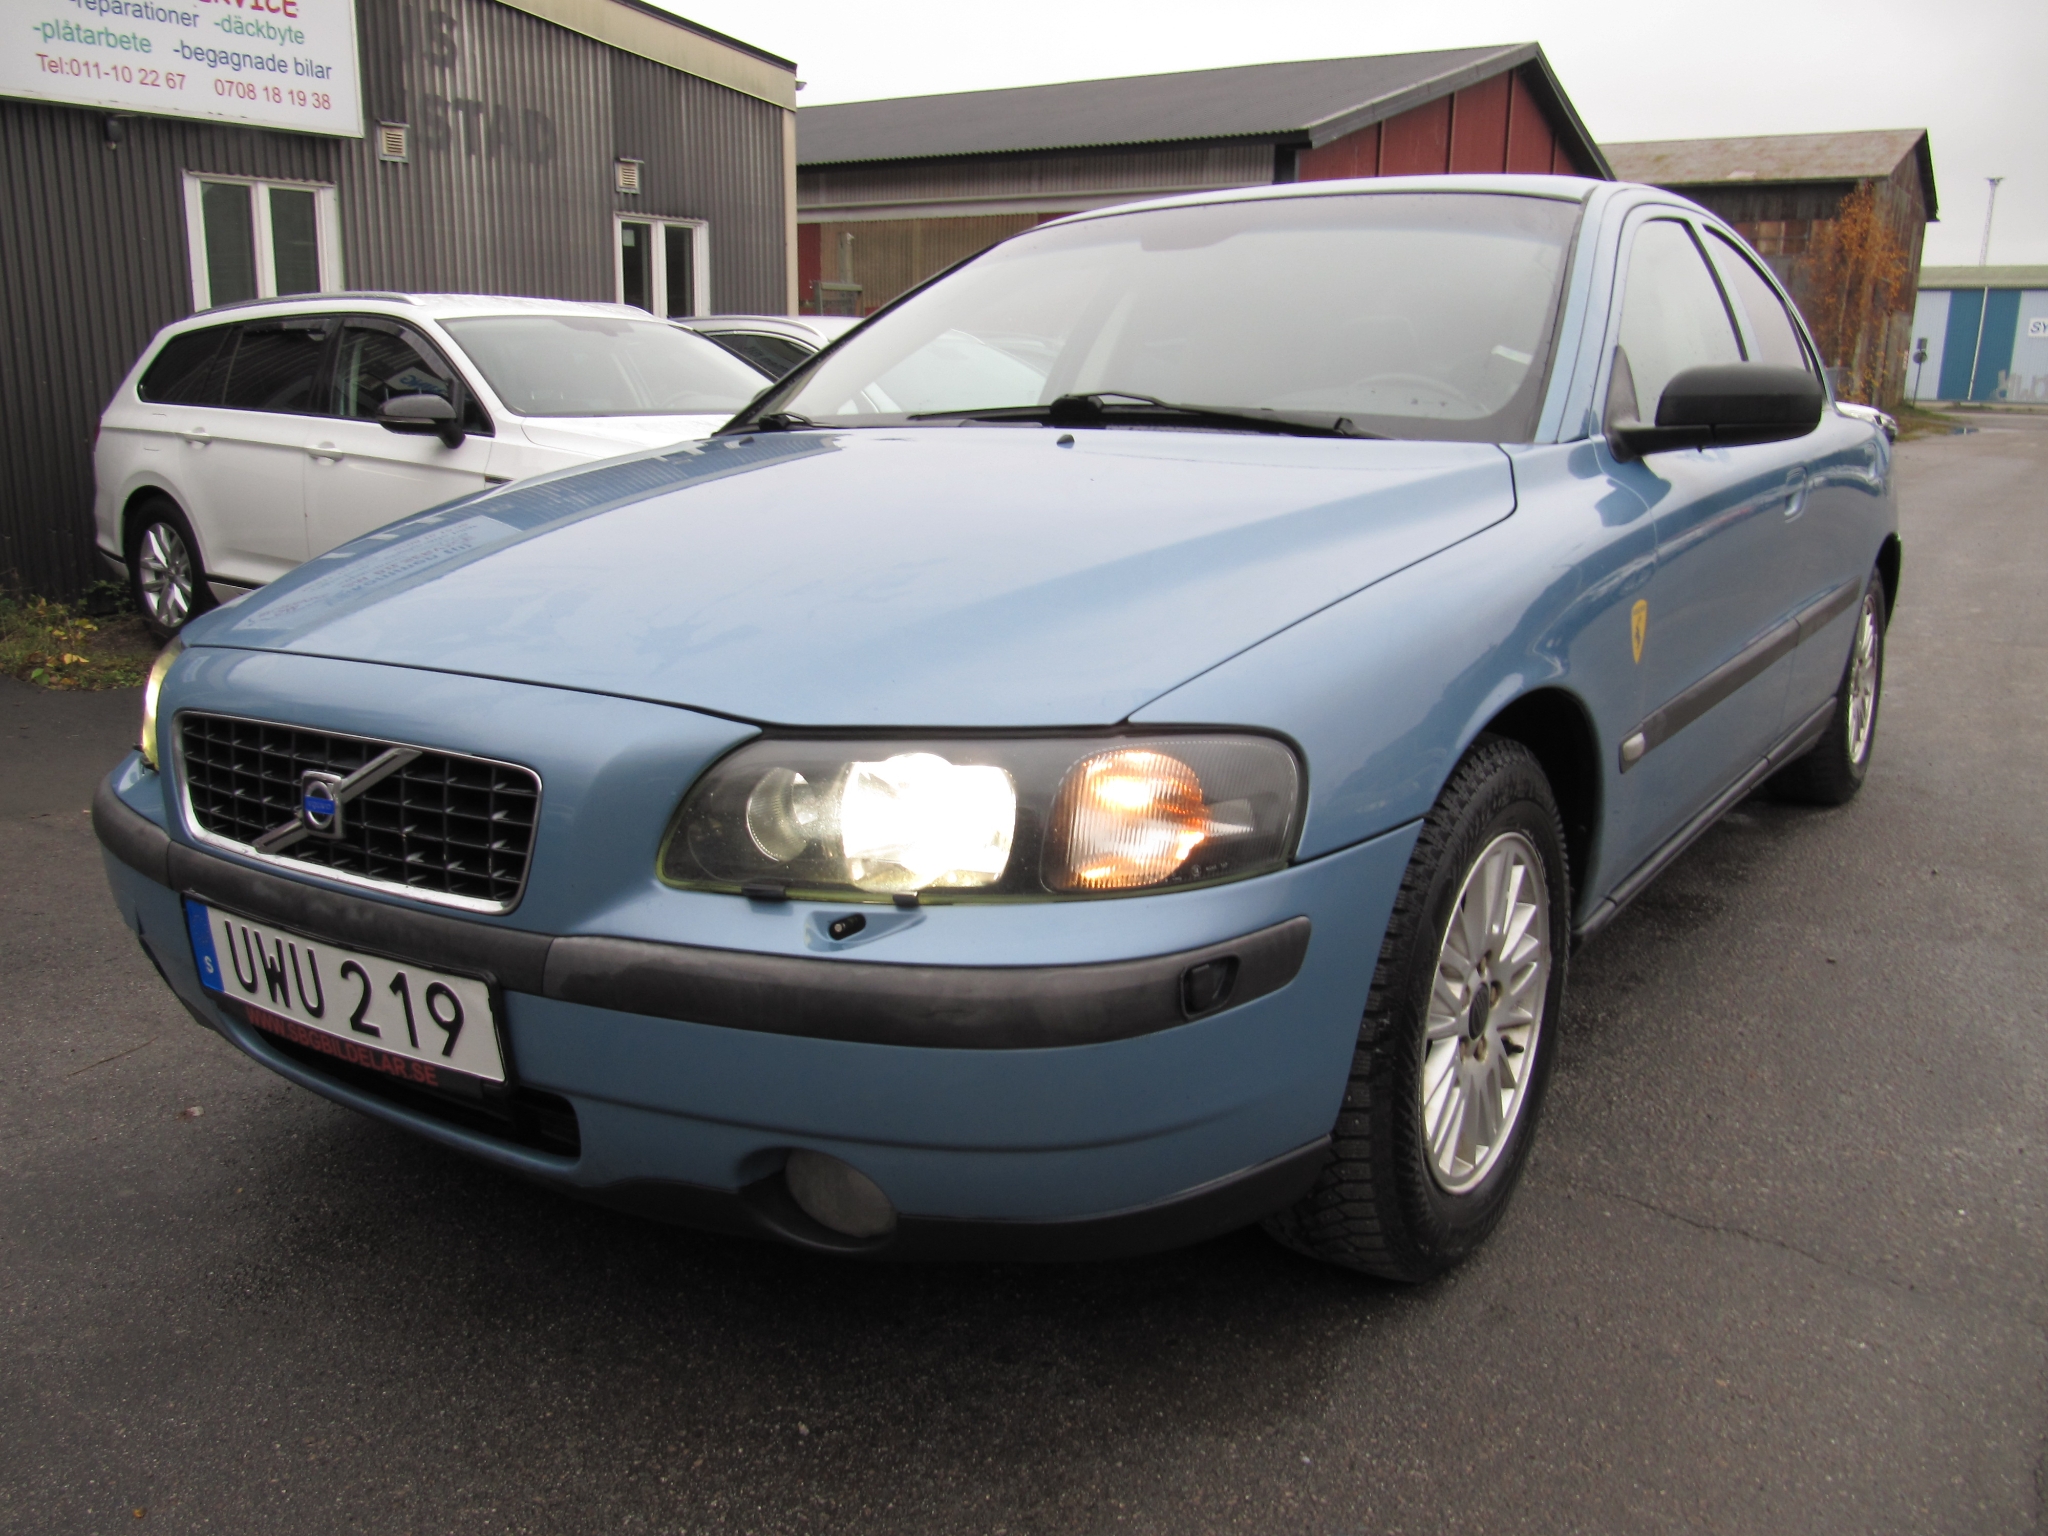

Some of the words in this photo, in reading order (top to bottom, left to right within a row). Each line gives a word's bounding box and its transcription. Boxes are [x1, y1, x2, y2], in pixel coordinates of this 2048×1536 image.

[33, 19, 152, 53] -plåtarbete
[173, 40, 288, 74] -begagnade
[294, 55, 331, 79] bilar
[214, 15, 305, 46] -däckbyte
[36, 53, 133, 83] Tel:011-10
[139, 67, 161, 87] 22
[166, 72, 186, 90] 67
[214, 79, 256, 100] 0708
[263, 84, 281, 104] 18
[288, 88, 306, 107] 19
[312, 92, 331, 110] 38
[203, 954, 215, 974] S
[224, 920, 325, 1019] UWU
[340, 959, 465, 1058] 219
